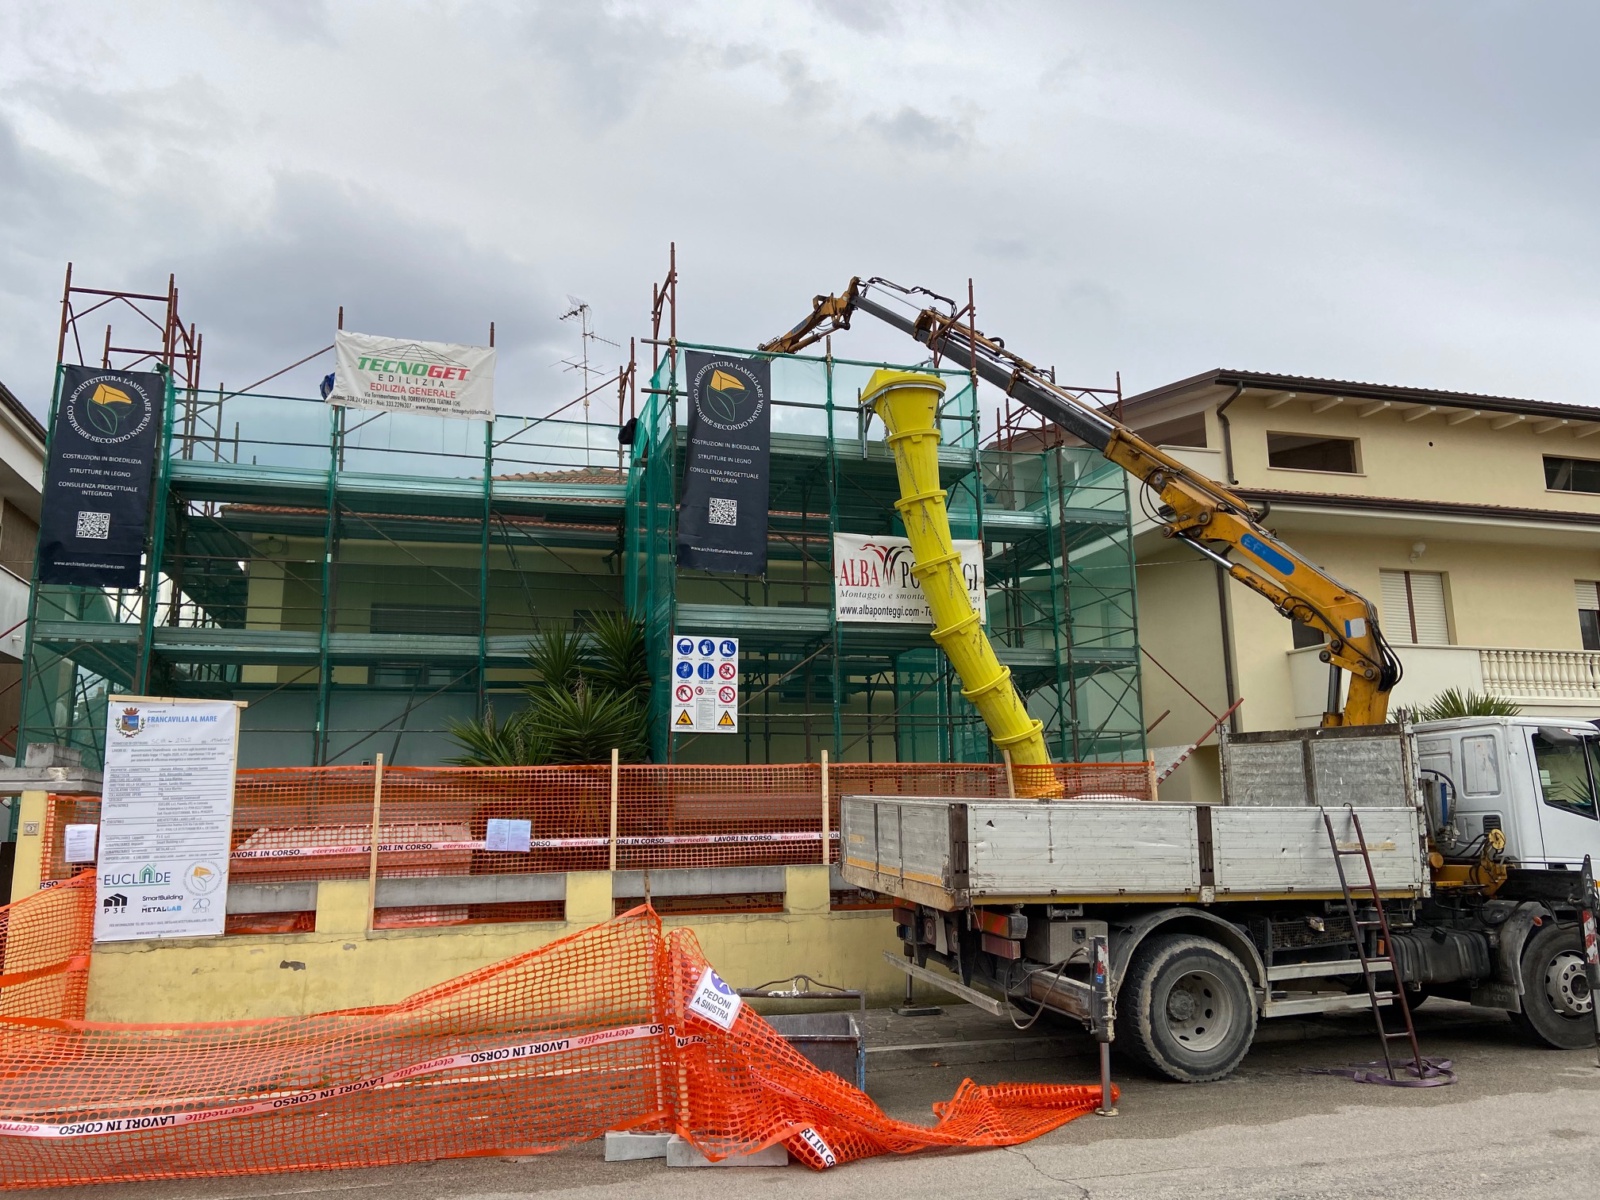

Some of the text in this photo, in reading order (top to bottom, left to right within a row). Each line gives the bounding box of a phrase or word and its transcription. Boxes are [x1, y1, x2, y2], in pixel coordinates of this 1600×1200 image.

[358, 357, 470, 380] TECNOGET
[378, 374, 444, 388] EDILIZIA
[694, 361, 764, 398] ARCHITETTURA LAMELLARE
[70, 376, 152, 412] ARCHITETTURA LAMELLARE
[370, 383, 456, 398] EDILIZIA GENERALE
[713, 422, 748, 431] SECONDO
[748, 400, 764, 424] NATURA
[67, 406, 152, 443] COSTRUIRE SECONDO NATURA
[692, 438, 723, 448] COSTRUZIONI
[62, 453, 100, 461] COSTRUZIONI
[698, 454, 727, 462] STRUTTURE
[690, 466, 759, 479] CONSULENZA PROGETTUALE
[97, 484, 138, 492] PROGETTUALE
[54, 561, 125, 570] www.architetturalamellare.com
[839, 559, 880, 587] ALBA
[840, 590, 885, 600] Montaggio
[840, 605, 919, 618] www.albaponteggi.com
[230, 850, 258, 858] AVORI
[312, 846, 356, 855] eternedile
[703, 988, 732, 1009] PEDONI
[700, 1000, 729, 1021] SINISTRA
[577, 1028, 635, 1044] eternedile
[471, 1040, 569, 1062] LAVORI IN CORSO
[392, 1057, 455, 1078] eternedile
[273, 1077, 384, 1107] LAVORI IN CORSO
[185, 1105, 255, 1121] eternedile
[0, 1122, 40, 1132] etern
[59, 1116, 175, 1135] LAVORI IN CORSO
[812, 1140, 827, 1154] IN
